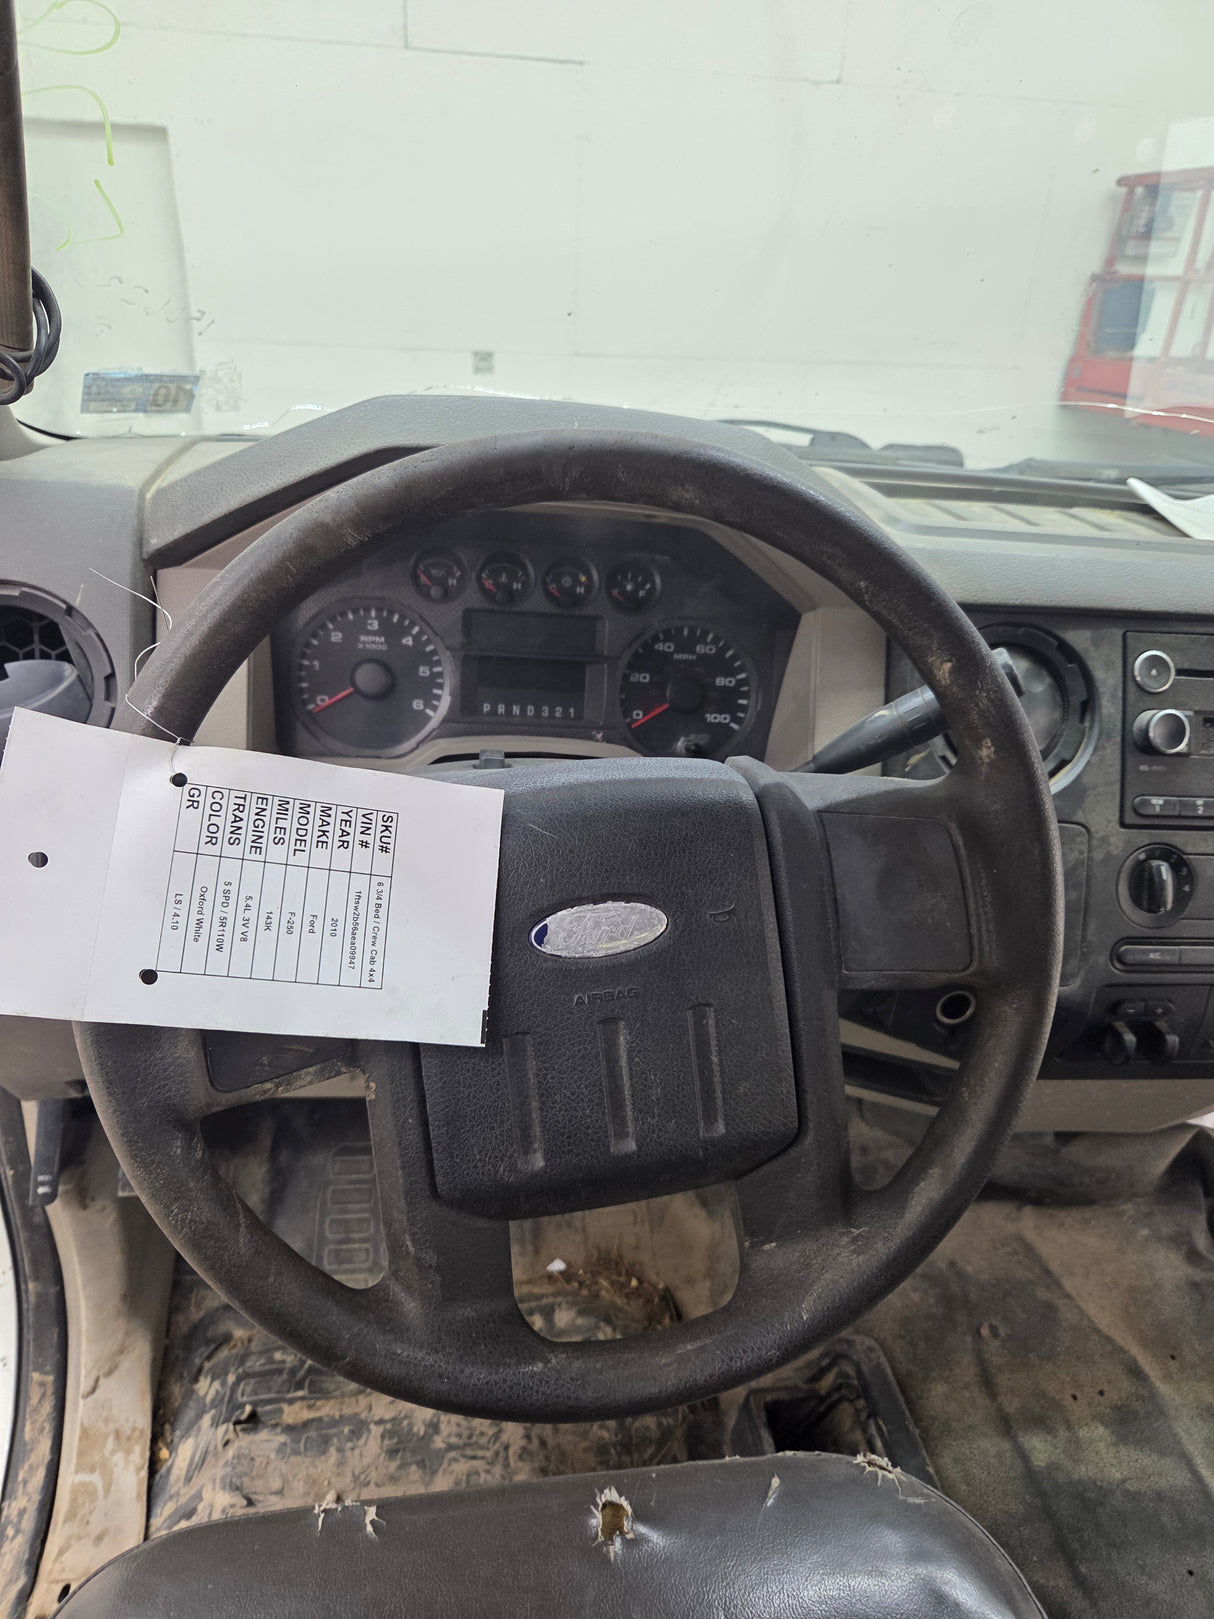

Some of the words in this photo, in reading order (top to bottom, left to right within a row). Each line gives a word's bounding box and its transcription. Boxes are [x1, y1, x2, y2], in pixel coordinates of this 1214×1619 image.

[367, 619, 379, 630] 3
[331, 631, 343, 642] 2
[359, 635, 385, 643] RPM
[402, 636, 414, 646] 4
[654, 642, 675, 652] 40
[695, 644, 716, 654] 60
[418, 666, 430, 676] 5
[630, 673, 650, 682] 20
[715, 677, 736, 686] 80
[316, 695, 329, 706] 0
[412, 699, 424, 710] 6
[483, 703, 491, 714] P
[497, 703, 506, 715] R
[512, 704, 520, 716] N
[527, 705, 535, 716] D
[541, 705, 549, 717] 3
[555, 706, 562, 718] 2
[568, 707, 575, 718] 1
[632, 710, 643, 719] 0
[704, 713, 731, 723] 100
[185, 787, 202, 809] GR
[204, 790, 224, 846] COLOR
[228, 794, 247, 846] TRANS
[249, 796, 268, 855] ENGINE
[272, 799, 290, 846] MILES
[360, 812, 374, 836] VIN
[292, 802, 311, 857] MODEL
[315, 805, 332, 850] MAKE
[337, 809, 353, 850] YEAR
[378, 814, 394, 854] SKU#
[358, 839, 370, 849] #
[174, 893, 183, 905] LS
[196, 885, 208, 916] Oxford
[221, 888, 231, 908] SPD
[374, 888, 383, 901] 3/4
[243, 895, 253, 914] 5.4L
[373, 903, 382, 919] Bed
[170, 912, 181, 931] 4.10
[192, 917, 204, 943] White
[241, 916, 251, 929] 3V
[264, 911, 274, 932] 143K
[285, 911, 296, 935] F-250
[308, 914, 318, 934] Ford
[329, 917, 338, 938] 2010
[215, 915, 228, 953] 5R110W
[239, 930, 249, 942] V8
[371, 926, 380, 947] Crew
[369, 949, 378, 966] Cab
[367, 968, 376, 983] 4x4
[572, 986, 639, 1007] AIRBAG
